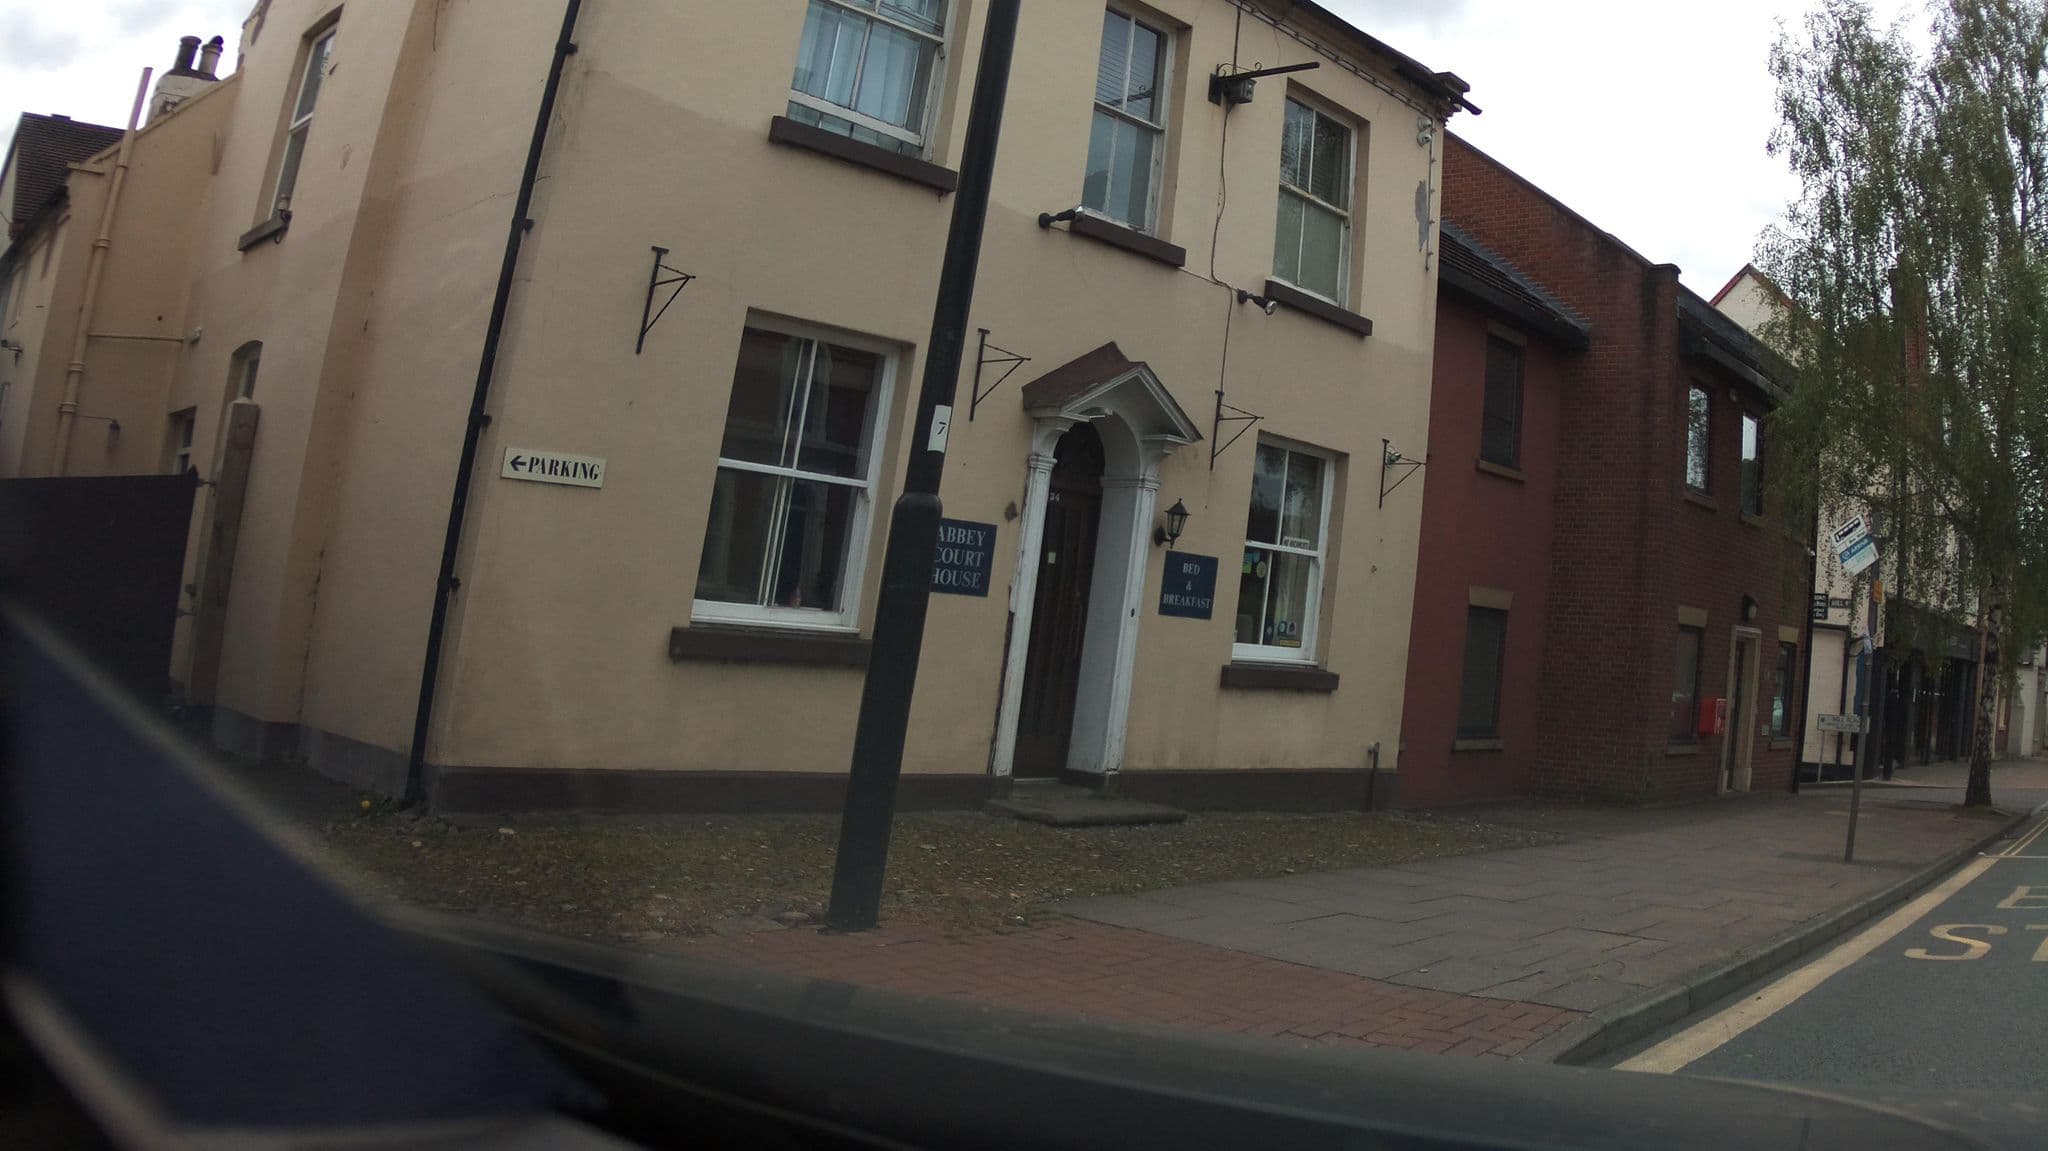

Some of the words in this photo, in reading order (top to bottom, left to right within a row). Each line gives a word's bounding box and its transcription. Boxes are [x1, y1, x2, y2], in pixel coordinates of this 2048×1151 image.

[937, 421, 947, 435] 7
[528, 456, 600, 481] PARKING
[938, 526, 986, 547] ABBEY
[1183, 562, 1200, 576] BED
[931, 568, 982, 589] HOUSE
[1185, 580, 1192, 591] &
[1163, 594, 1211, 609] BREAKFAST
